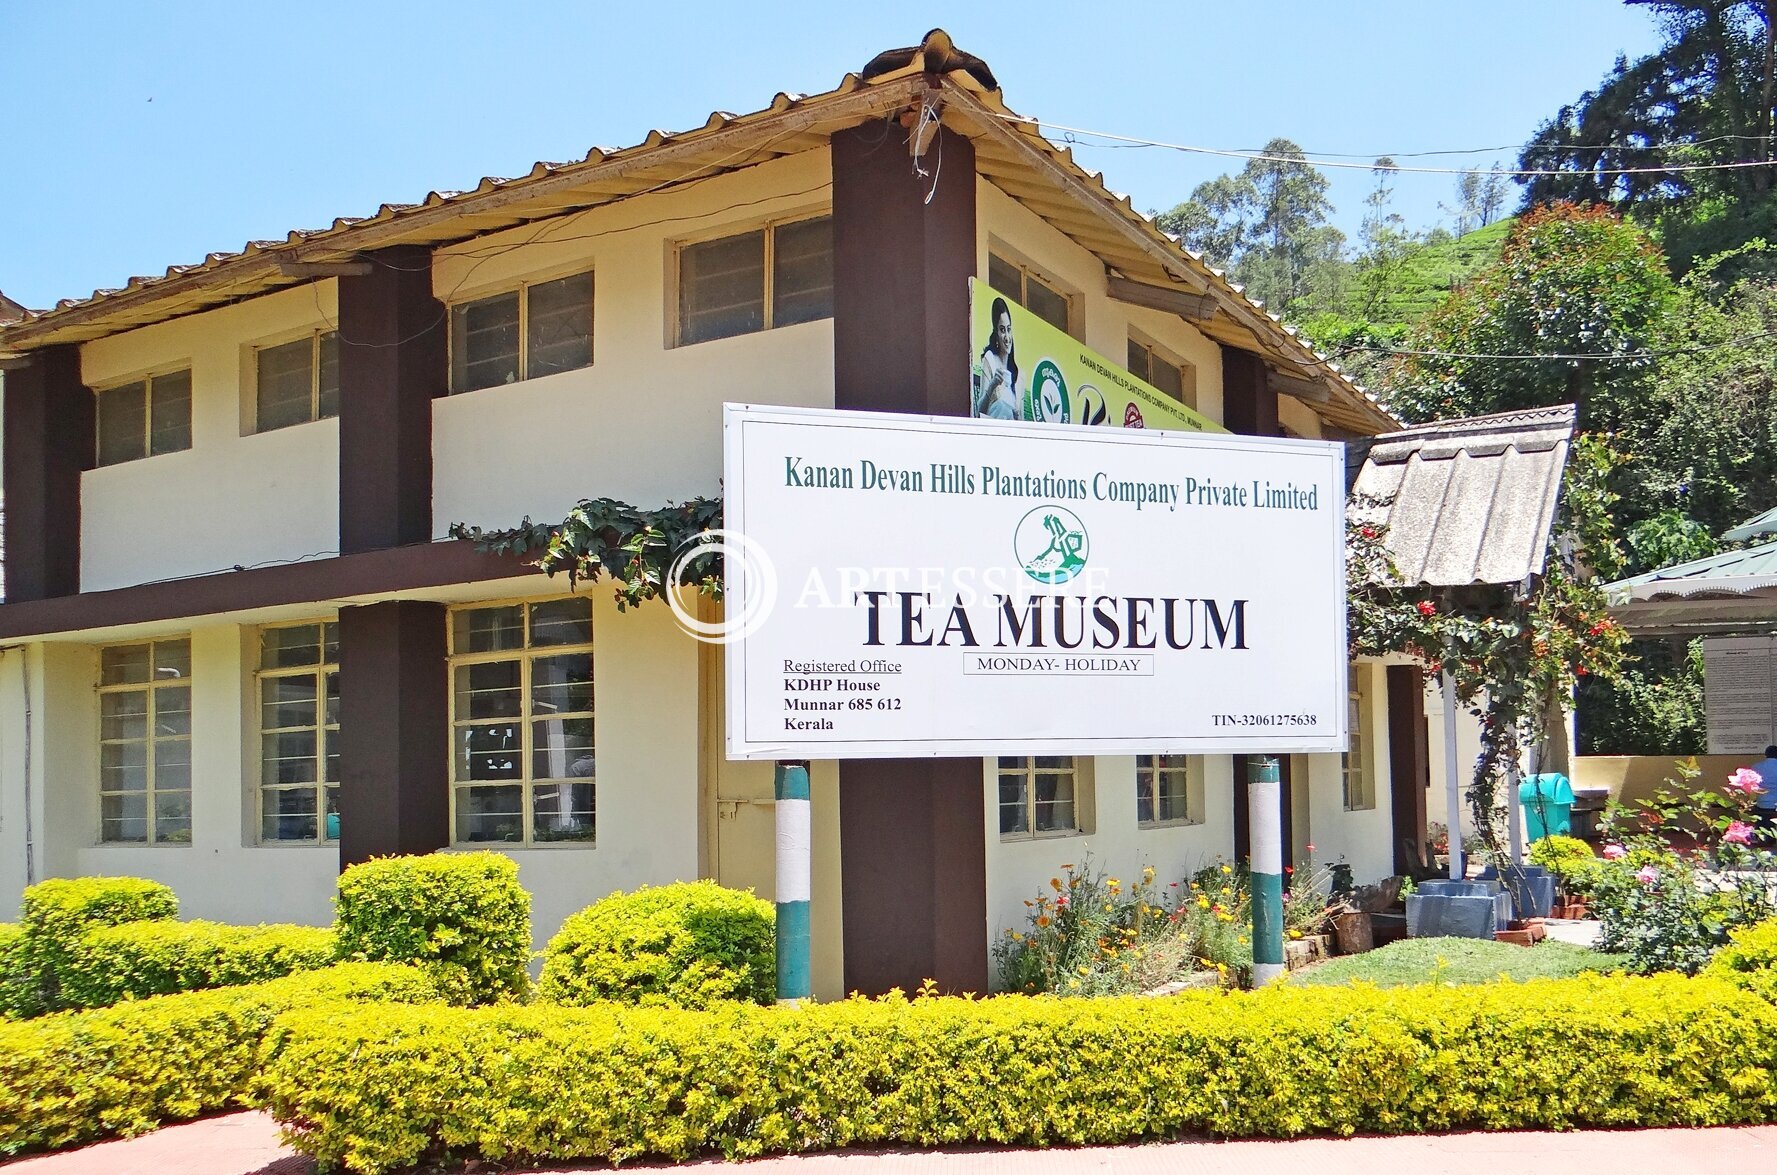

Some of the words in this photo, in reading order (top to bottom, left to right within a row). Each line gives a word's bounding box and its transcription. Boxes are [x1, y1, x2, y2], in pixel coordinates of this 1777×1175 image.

[1079, 353, 1097, 371] KANAN
[1096, 363, 1112, 381] DEVAN
[1111, 373, 1125, 388] HILLS
[1124, 380, 1152, 403] PLANTATIONS
[1151, 396, 1171, 413] COMPANY
[785, 457, 853, 489] Kanan
[860, 460, 924, 493] Devan
[930, 464, 975, 496] Hills
[982, 467, 1087, 500] Plantations
[1093, 472, 1180, 512] Company
[1186, 476, 1248, 508] Private
[1253, 480, 1318, 511] Limited
[855, 592, 980, 647] TEA
[993, 594, 1250, 650] MUSEUM
[783, 659, 856, 675] Registered
[860, 659, 902, 672] Office
[977, 657, 1060, 671] MONDAY-
[1064, 658, 1141, 671] HOLIDAY
[784, 679, 833, 691] KDHP
[837, 679, 881, 691] House
[784, 698, 844, 711] Munnar
[848, 698, 873, 711] 685
[877, 698, 902, 711] 612
[784, 717, 834, 730] Kerala
[1212, 714, 1318, 727] TIN-32061275638
